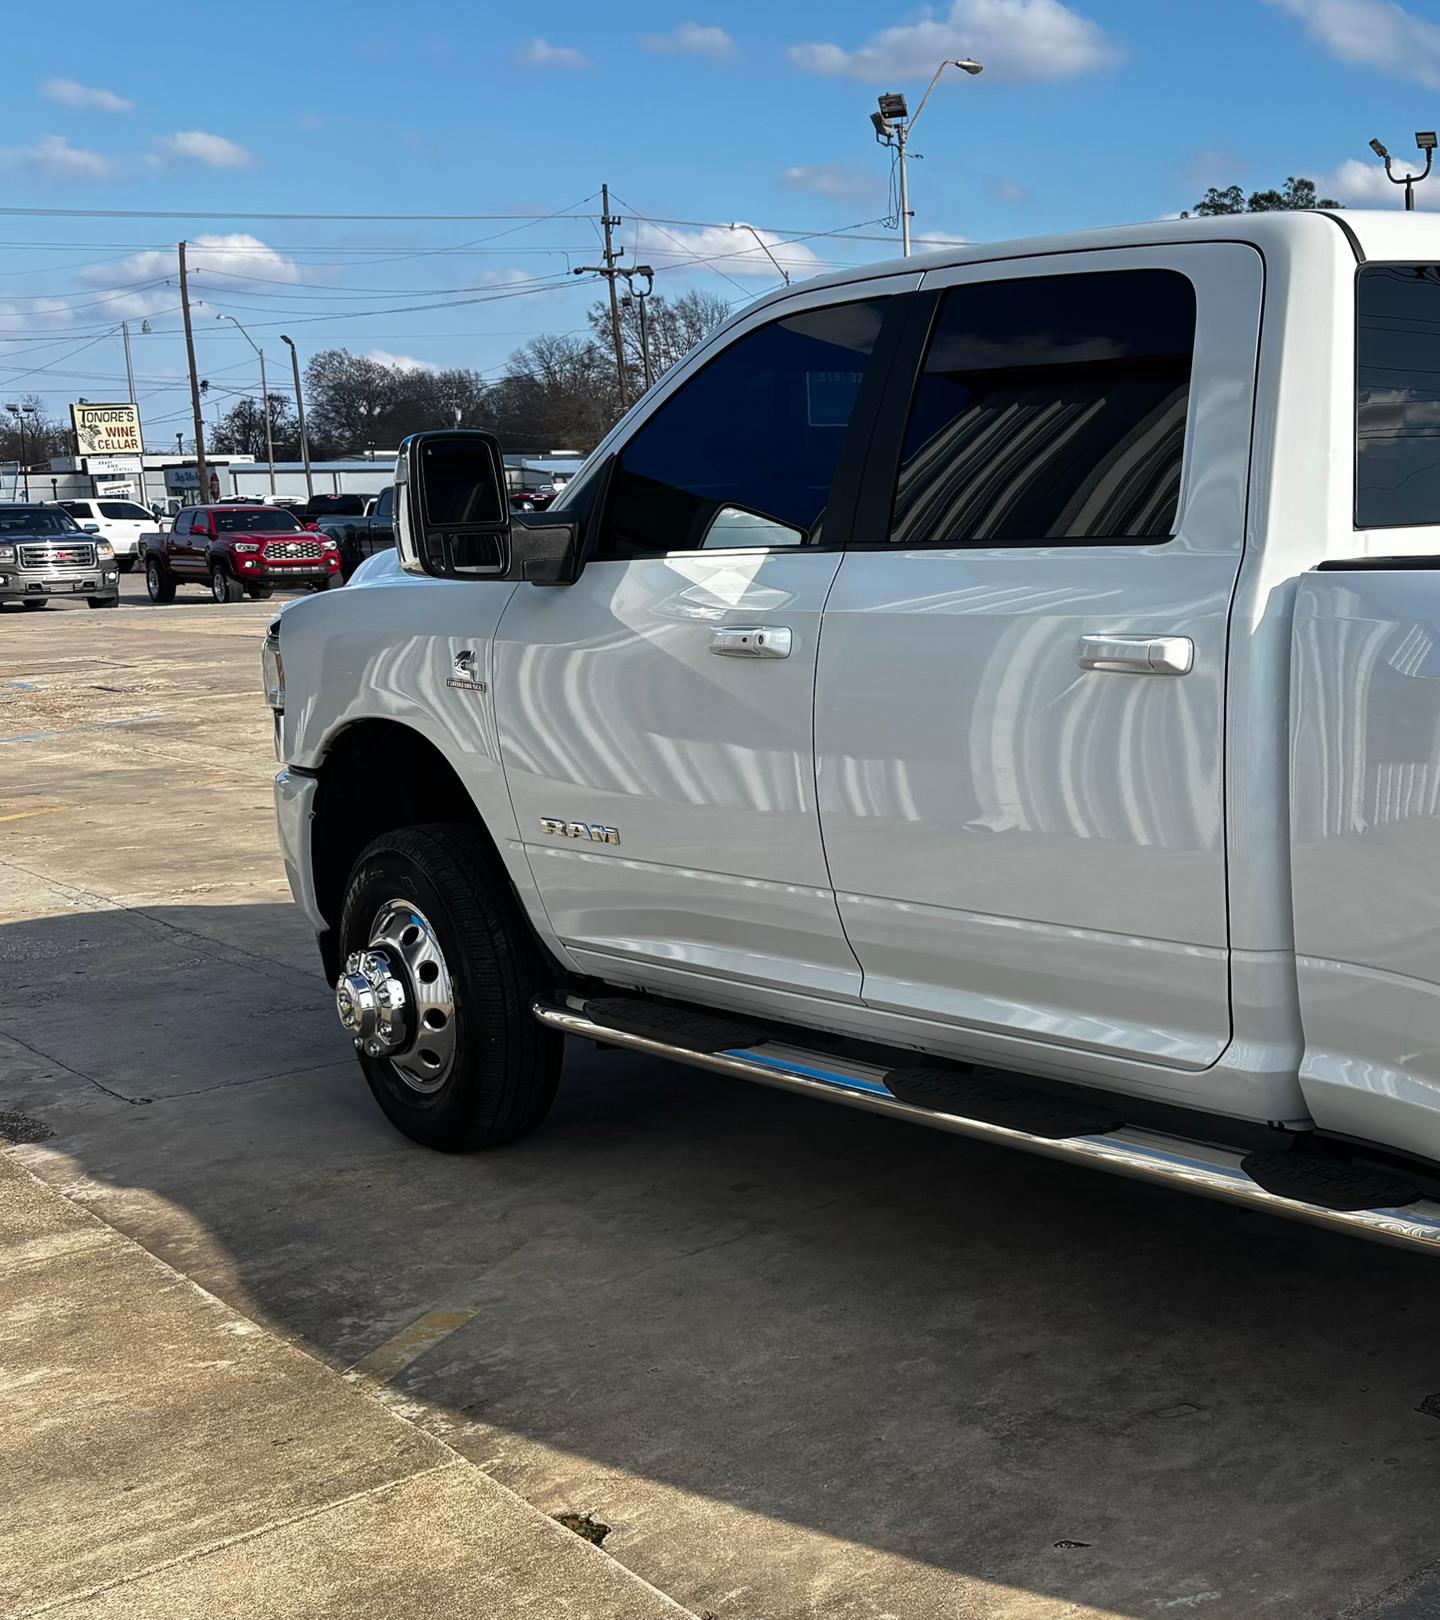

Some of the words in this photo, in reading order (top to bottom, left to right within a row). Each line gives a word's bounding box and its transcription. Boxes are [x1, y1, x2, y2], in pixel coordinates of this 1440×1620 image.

[77, 406, 134, 424] TONORE'S
[105, 426, 137, 437] WINE
[97, 439, 139, 450] CELLAR
[540, 817, 621, 845] RAM
